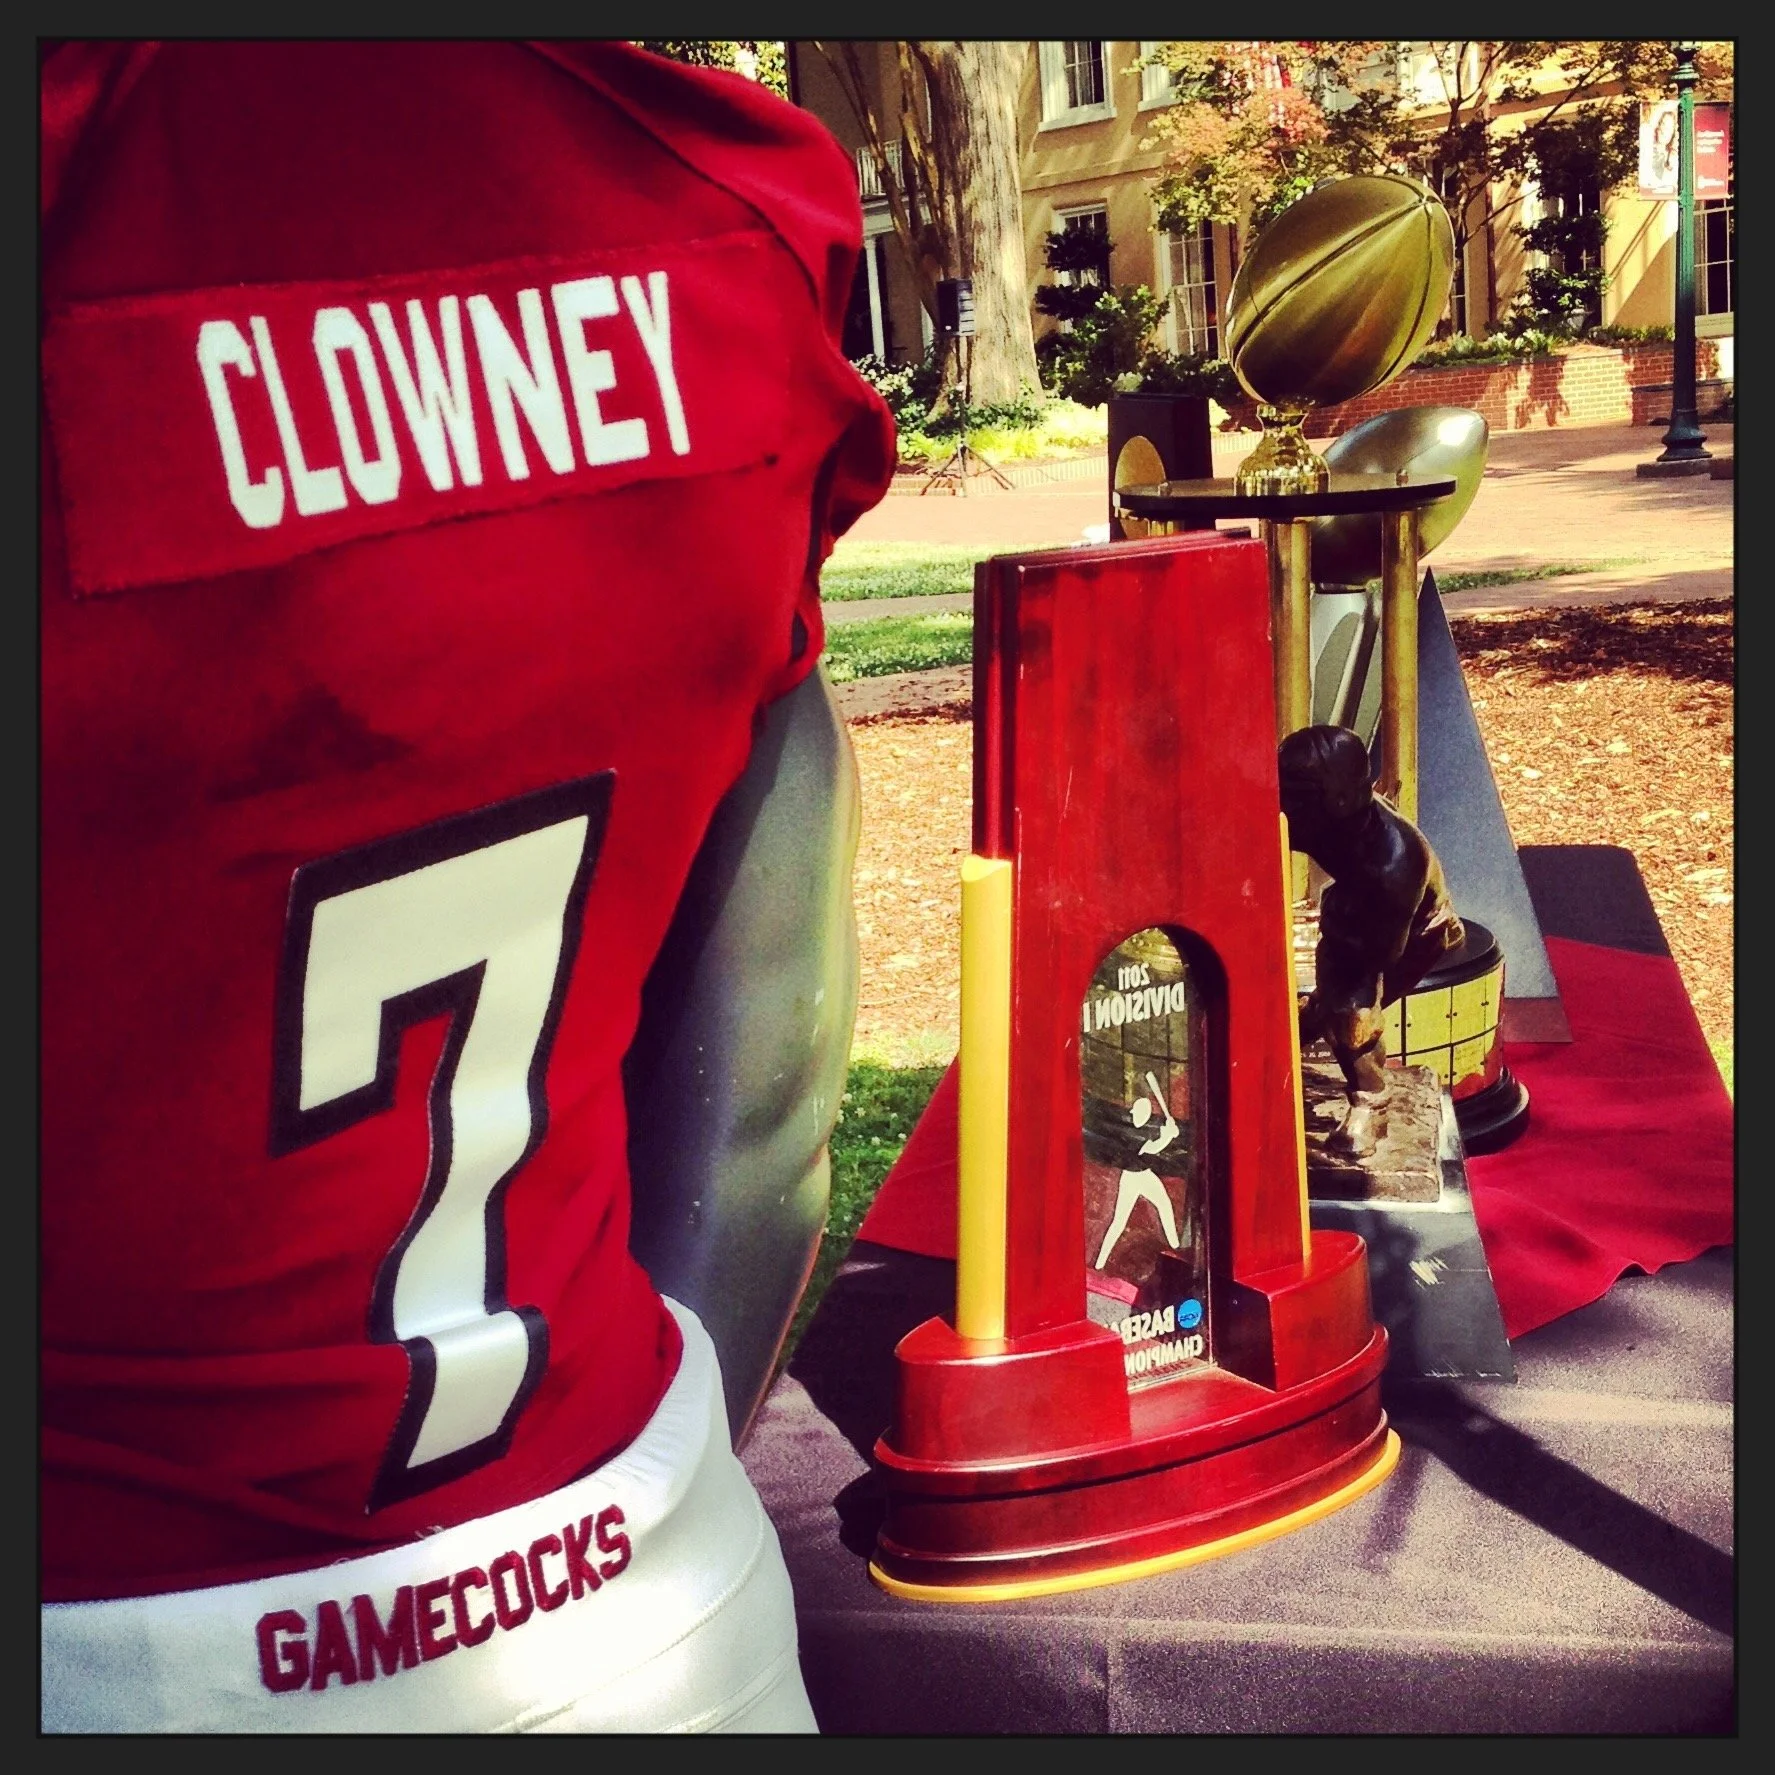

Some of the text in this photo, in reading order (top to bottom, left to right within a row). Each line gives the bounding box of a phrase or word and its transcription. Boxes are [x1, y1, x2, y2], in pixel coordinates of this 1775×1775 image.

[197, 270, 691, 529] CLOWNEY
[268, 768, 616, 1514] 7
[255, 1503, 632, 1693] GAMECOCKS
